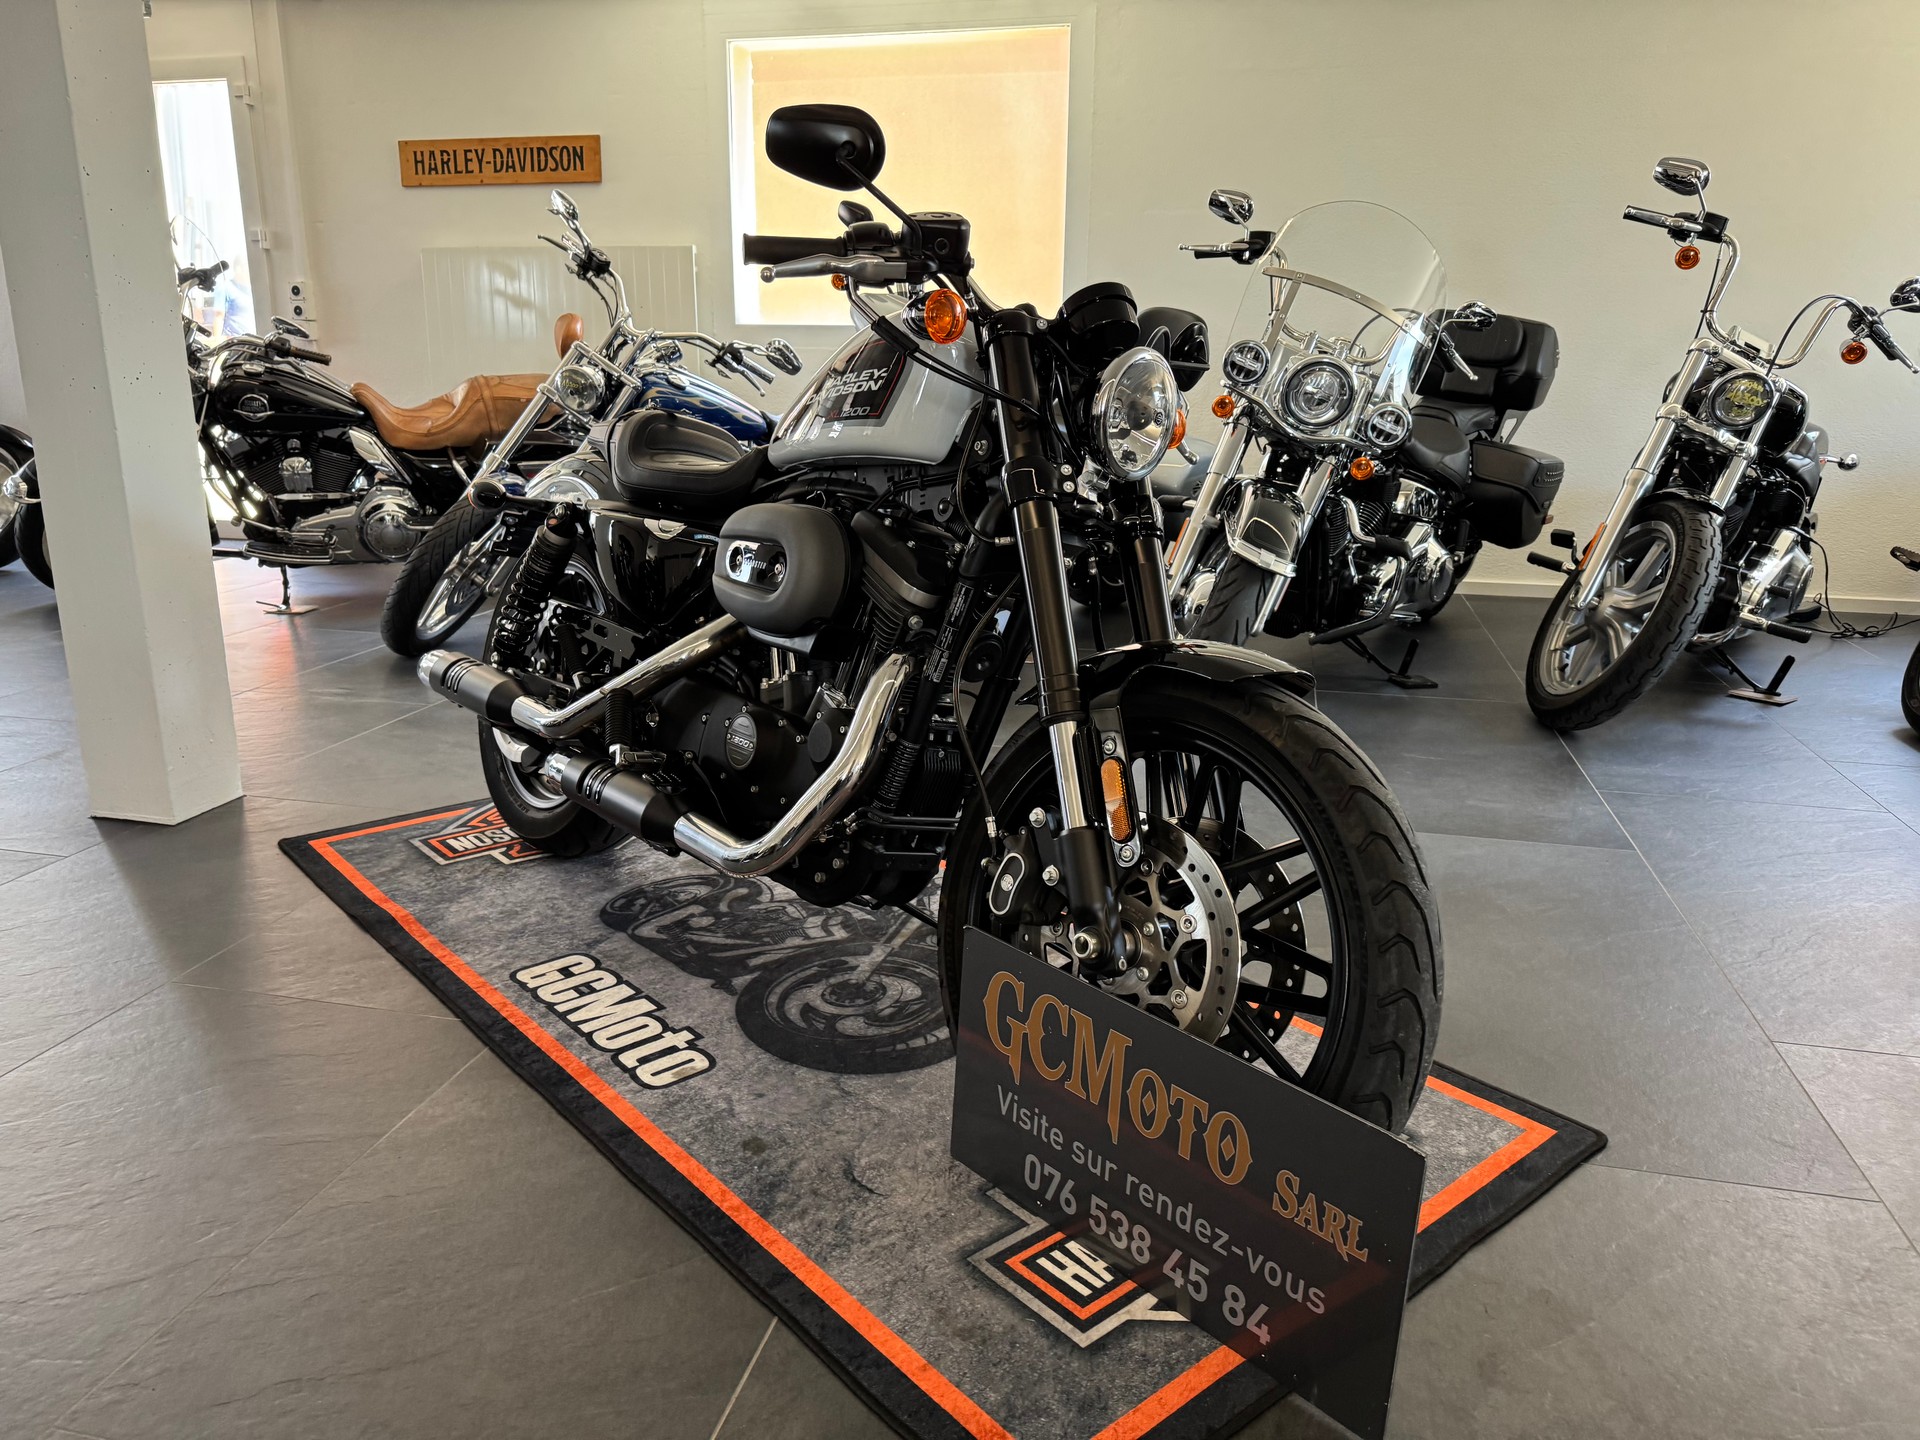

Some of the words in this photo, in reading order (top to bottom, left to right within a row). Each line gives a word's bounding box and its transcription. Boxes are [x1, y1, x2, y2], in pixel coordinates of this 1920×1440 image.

[413, 145, 585, 176] HARLEY-DAVIDSON
[806, 380, 884, 405] DAVIDSON
[731, 735, 749, 748] 1200
[514, 953, 711, 1088] GCMoto
[997, 1084, 1064, 1151] Visite
[1071, 1140, 1118, 1182] sur
[1126, 1173, 1326, 1314] rendez-vous
[1272, 1169, 1369, 1262] SARL
[1024, 1153, 1077, 1216] 076
[1088, 1193, 1151, 1264] 538
[1162, 1248, 1210, 1302] 45
[1222, 1284, 1271, 1345] 84
